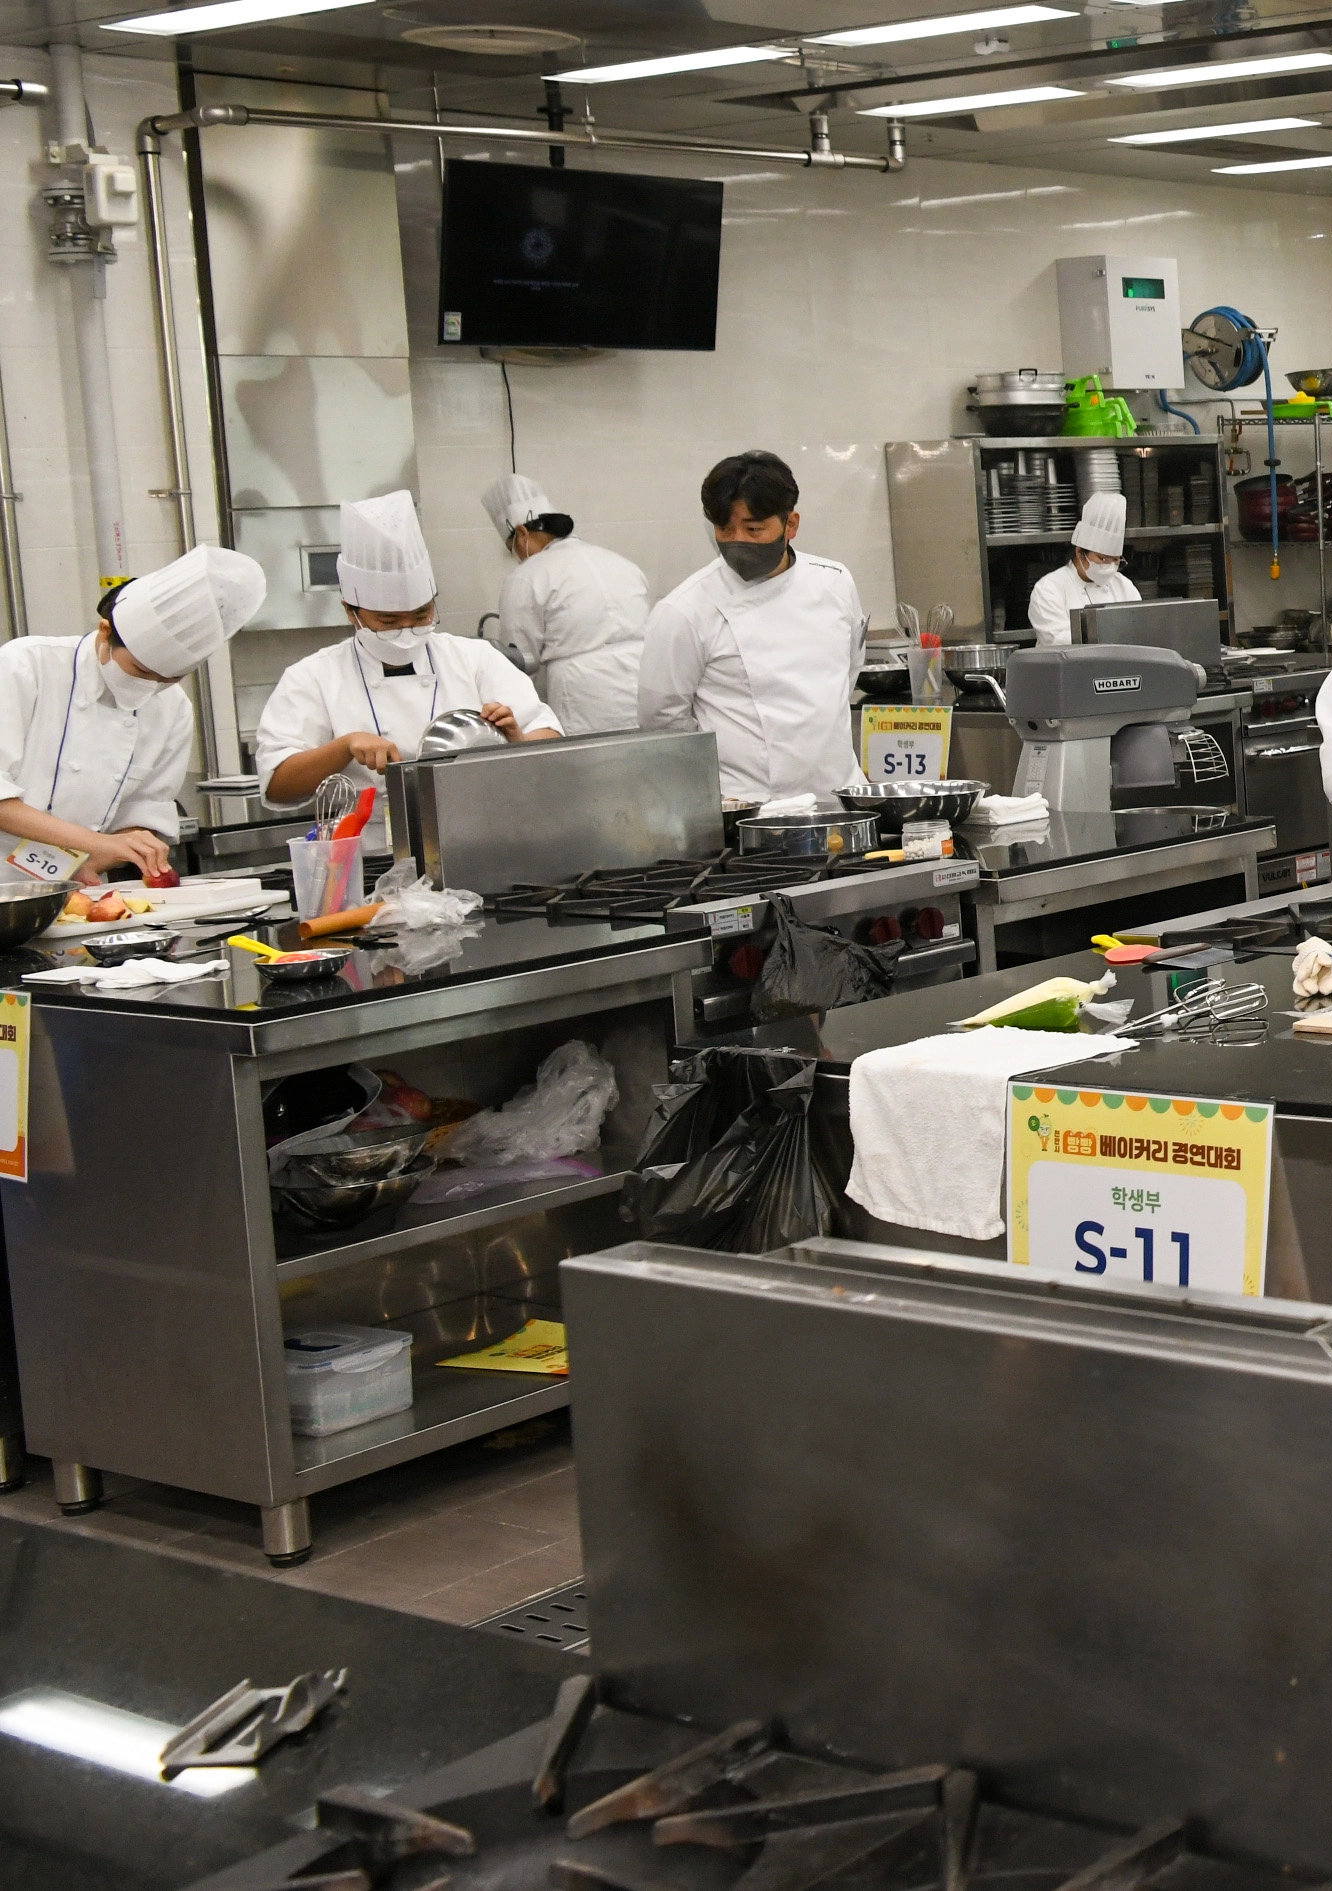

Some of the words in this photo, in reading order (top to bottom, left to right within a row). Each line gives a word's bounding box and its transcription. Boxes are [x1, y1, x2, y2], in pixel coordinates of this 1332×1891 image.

[1098, 679, 1137, 689] HOBART
[884, 753, 926, 775] S-13
[26, 852, 58, 875] S-10
[1067, 1136, 1093, 1154] 빵빵
[1100, 1134, 1168, 1162] 베이커리
[1172, 1141, 1241, 1171] 경연대회
[1111, 1186, 1162, 1214] 학생부
[1074, 1220, 1190, 1288] S-11
